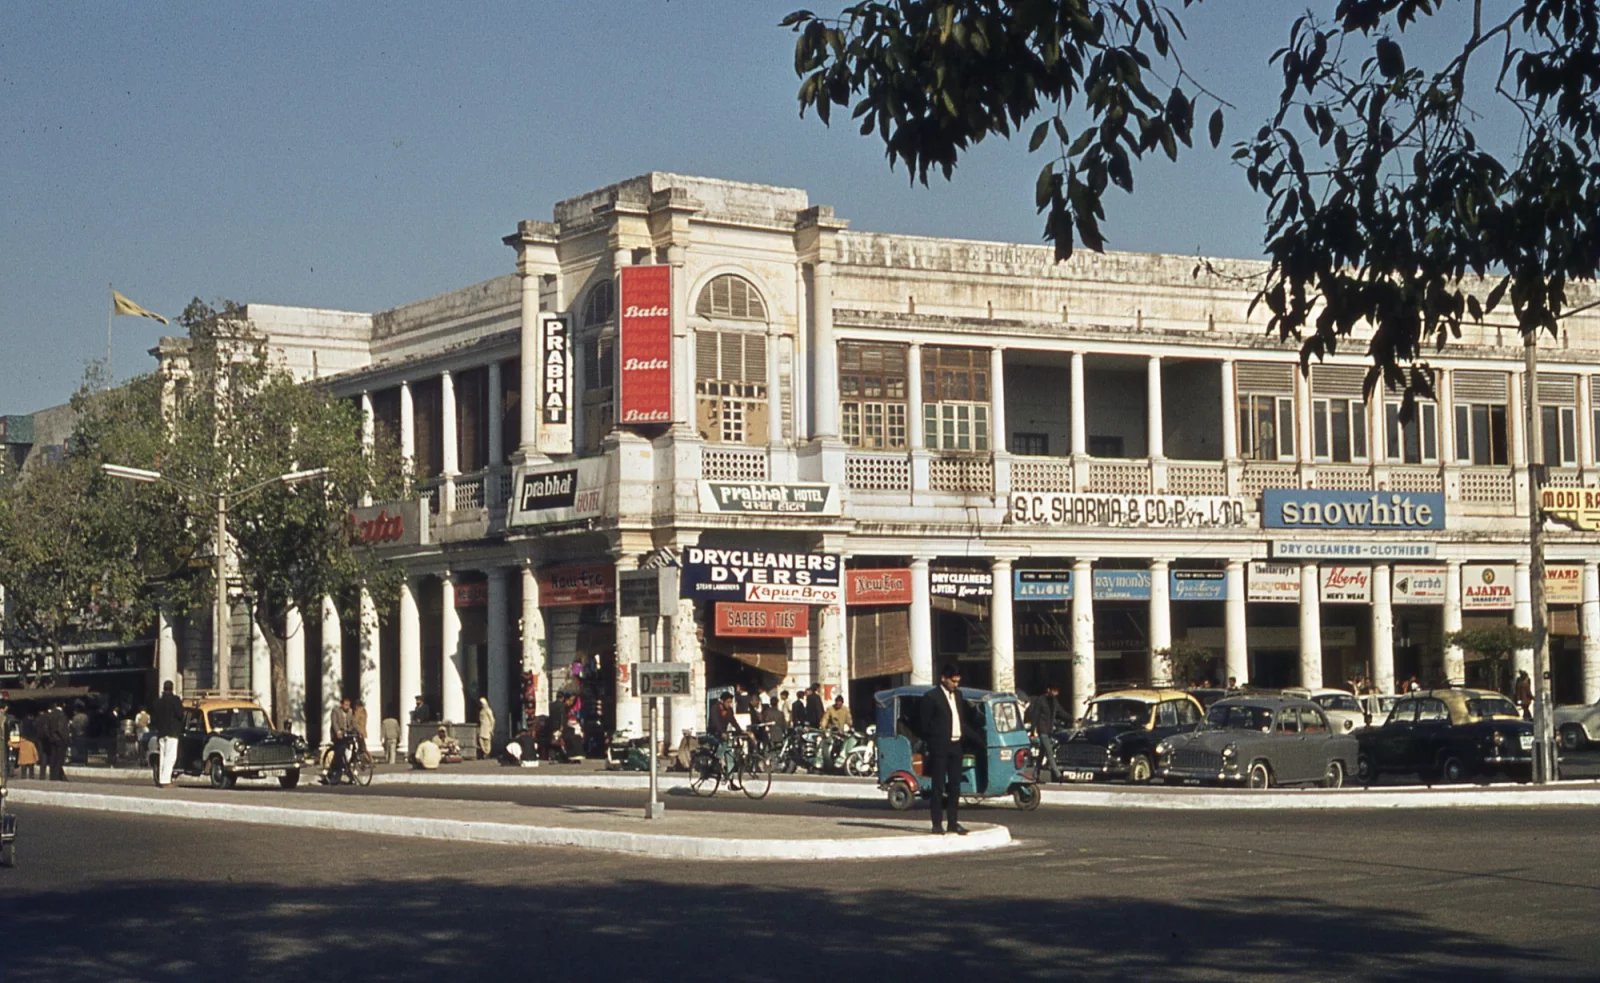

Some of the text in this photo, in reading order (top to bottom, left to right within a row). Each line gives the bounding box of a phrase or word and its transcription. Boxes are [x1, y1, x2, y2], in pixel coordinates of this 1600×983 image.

[624, 305, 669, 318] Bata
[546, 320, 563, 421] PRABHAT
[624, 358, 669, 371] Bata
[624, 409, 669, 422] Bata
[522, 473, 600, 513] prabhat HOTEL
[720, 484, 824, 504] prabhat HOTEL
[1543, 490, 1580, 508] MODI
[1051, 497, 1121, 523] SHARMA
[1128, 498, 1141, 523] &
[1282, 494, 1433, 526] snowhite
[1280, 544, 1302, 554] DRY
[689, 548, 836, 572] DRYCLEANERS
[711, 566, 812, 585] DYERS
[1095, 572, 1151, 589] Raymond's
[1324, 566, 1368, 589] Liberty
[748, 585, 799, 600] Kapur
[801, 588, 837, 600] Bros
[1346, 593, 1365, 601] WEAR
[1466, 586, 1511, 597] AJANTA
[727, 610, 796, 628] SAREES TIES
[641, 673, 651, 694] D
